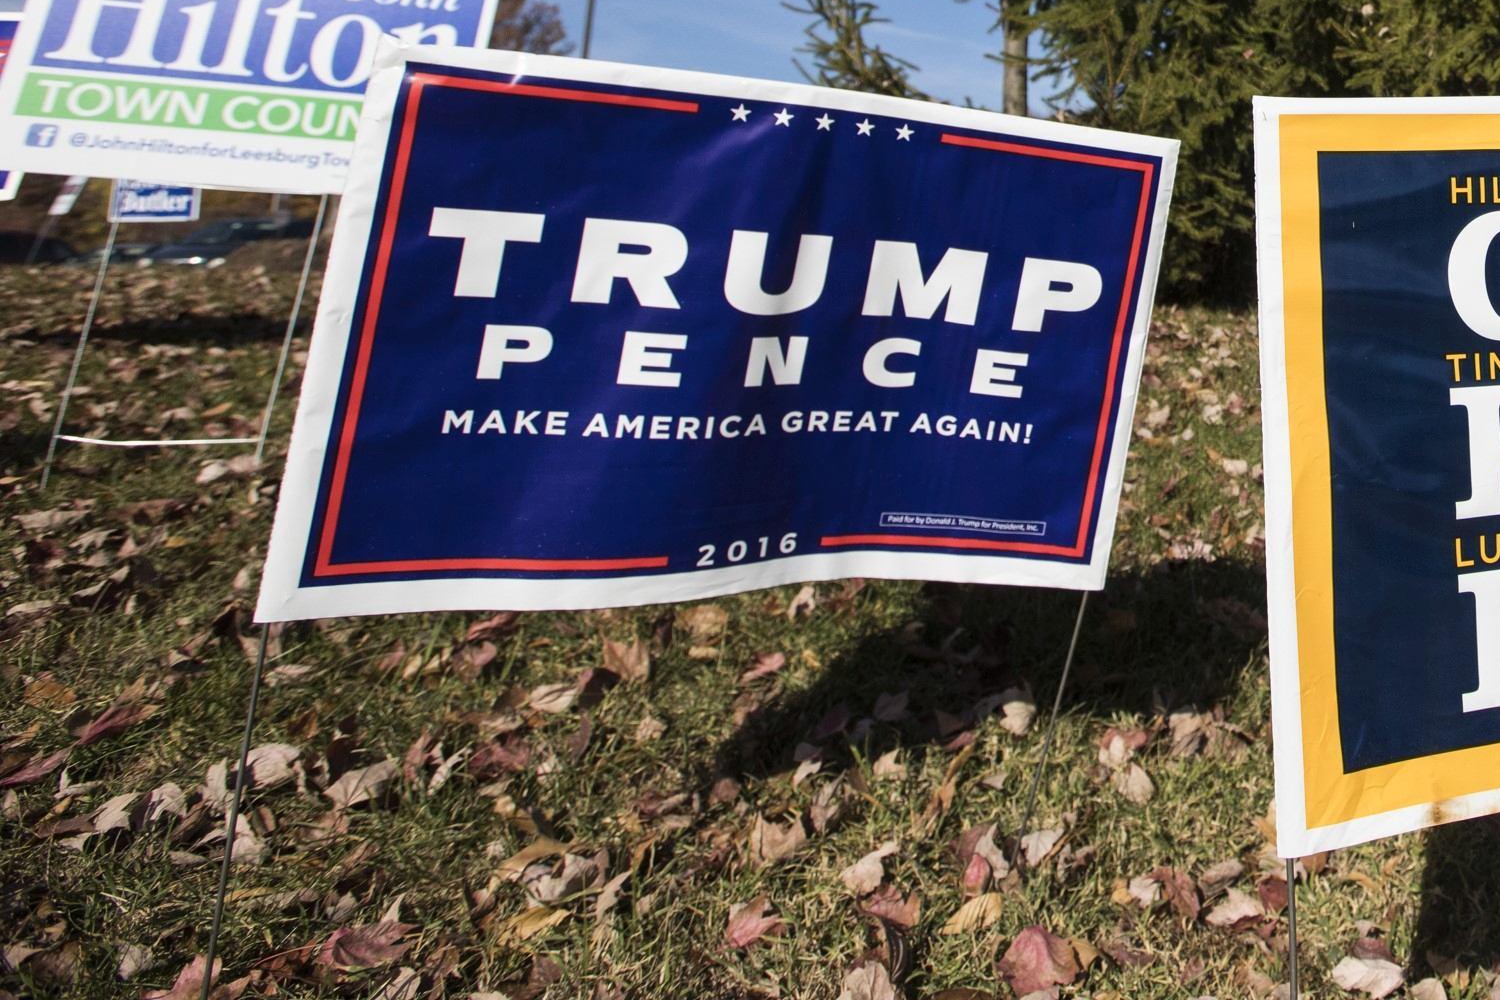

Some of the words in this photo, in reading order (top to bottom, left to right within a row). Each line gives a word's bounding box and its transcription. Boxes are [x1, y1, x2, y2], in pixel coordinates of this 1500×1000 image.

[37, 78, 208, 126] TOWN
[428, 206, 1103, 333] TRUMP
[476, 324, 1029, 399] PENCE
[441, 409, 569, 436] MAKE
[582, 412, 767, 441] AMERICA
[781, 410, 900, 434] GREAT
[909, 412, 1034, 445] AGAIN!
[915, 516, 925, 525] by
[925, 516, 951, 526] Donald
[959, 518, 980, 529] Trump
[981, 520, 992, 528] for
[696, 532, 797, 567] 2016
